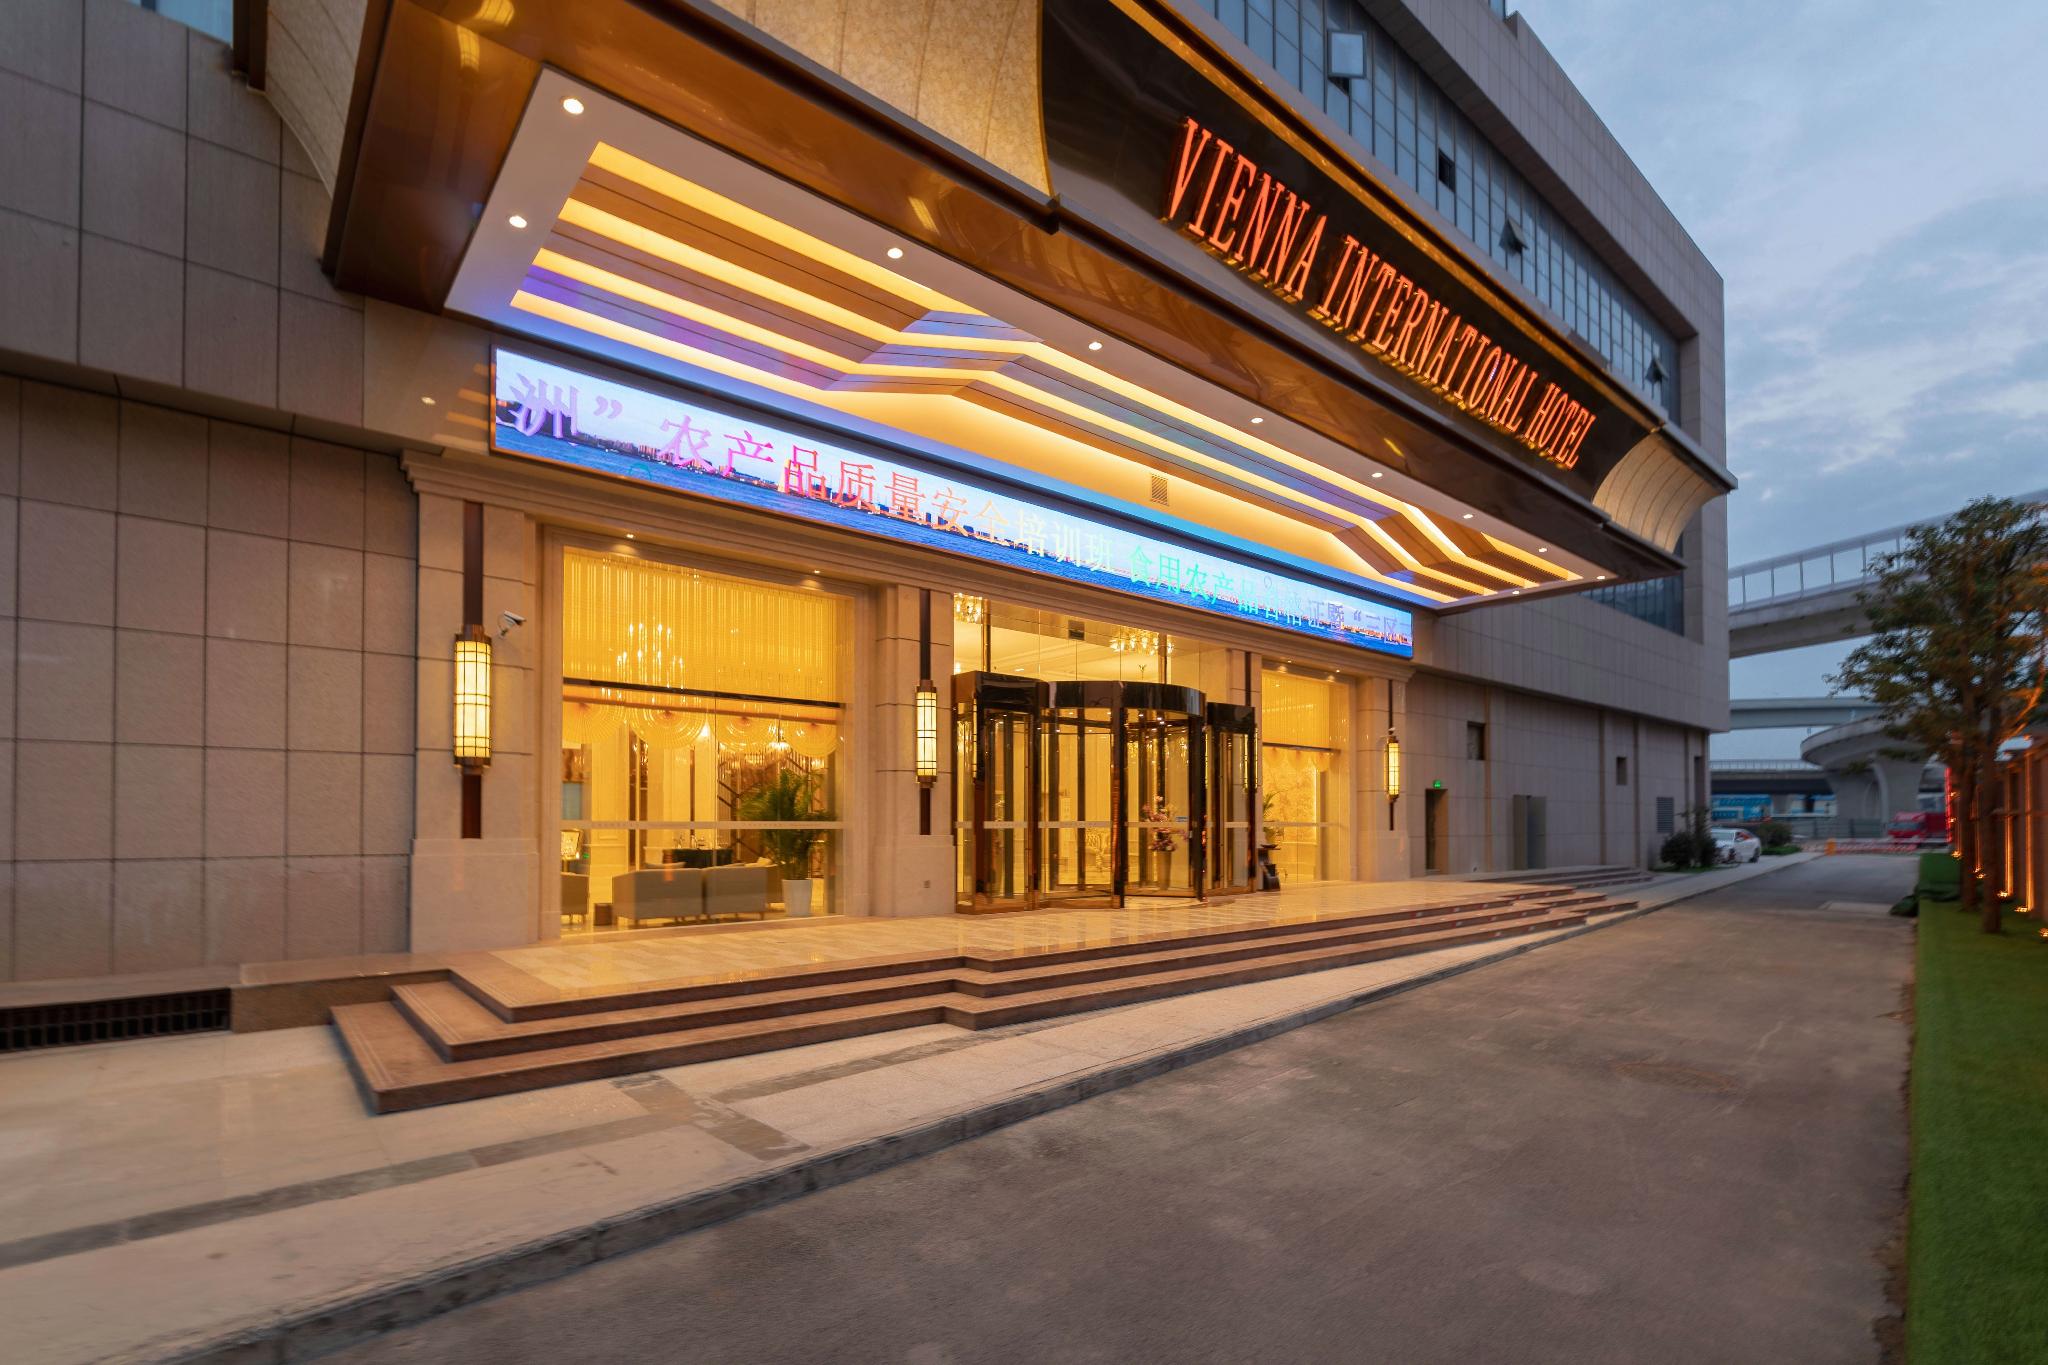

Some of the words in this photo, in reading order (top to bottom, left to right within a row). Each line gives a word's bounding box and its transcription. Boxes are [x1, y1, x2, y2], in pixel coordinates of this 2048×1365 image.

[1169, 117, 1329, 300] VIENNA
[1317, 235, 1539, 433] INTERNATIONAL
[1524, 383, 1597, 469] HOTEL
